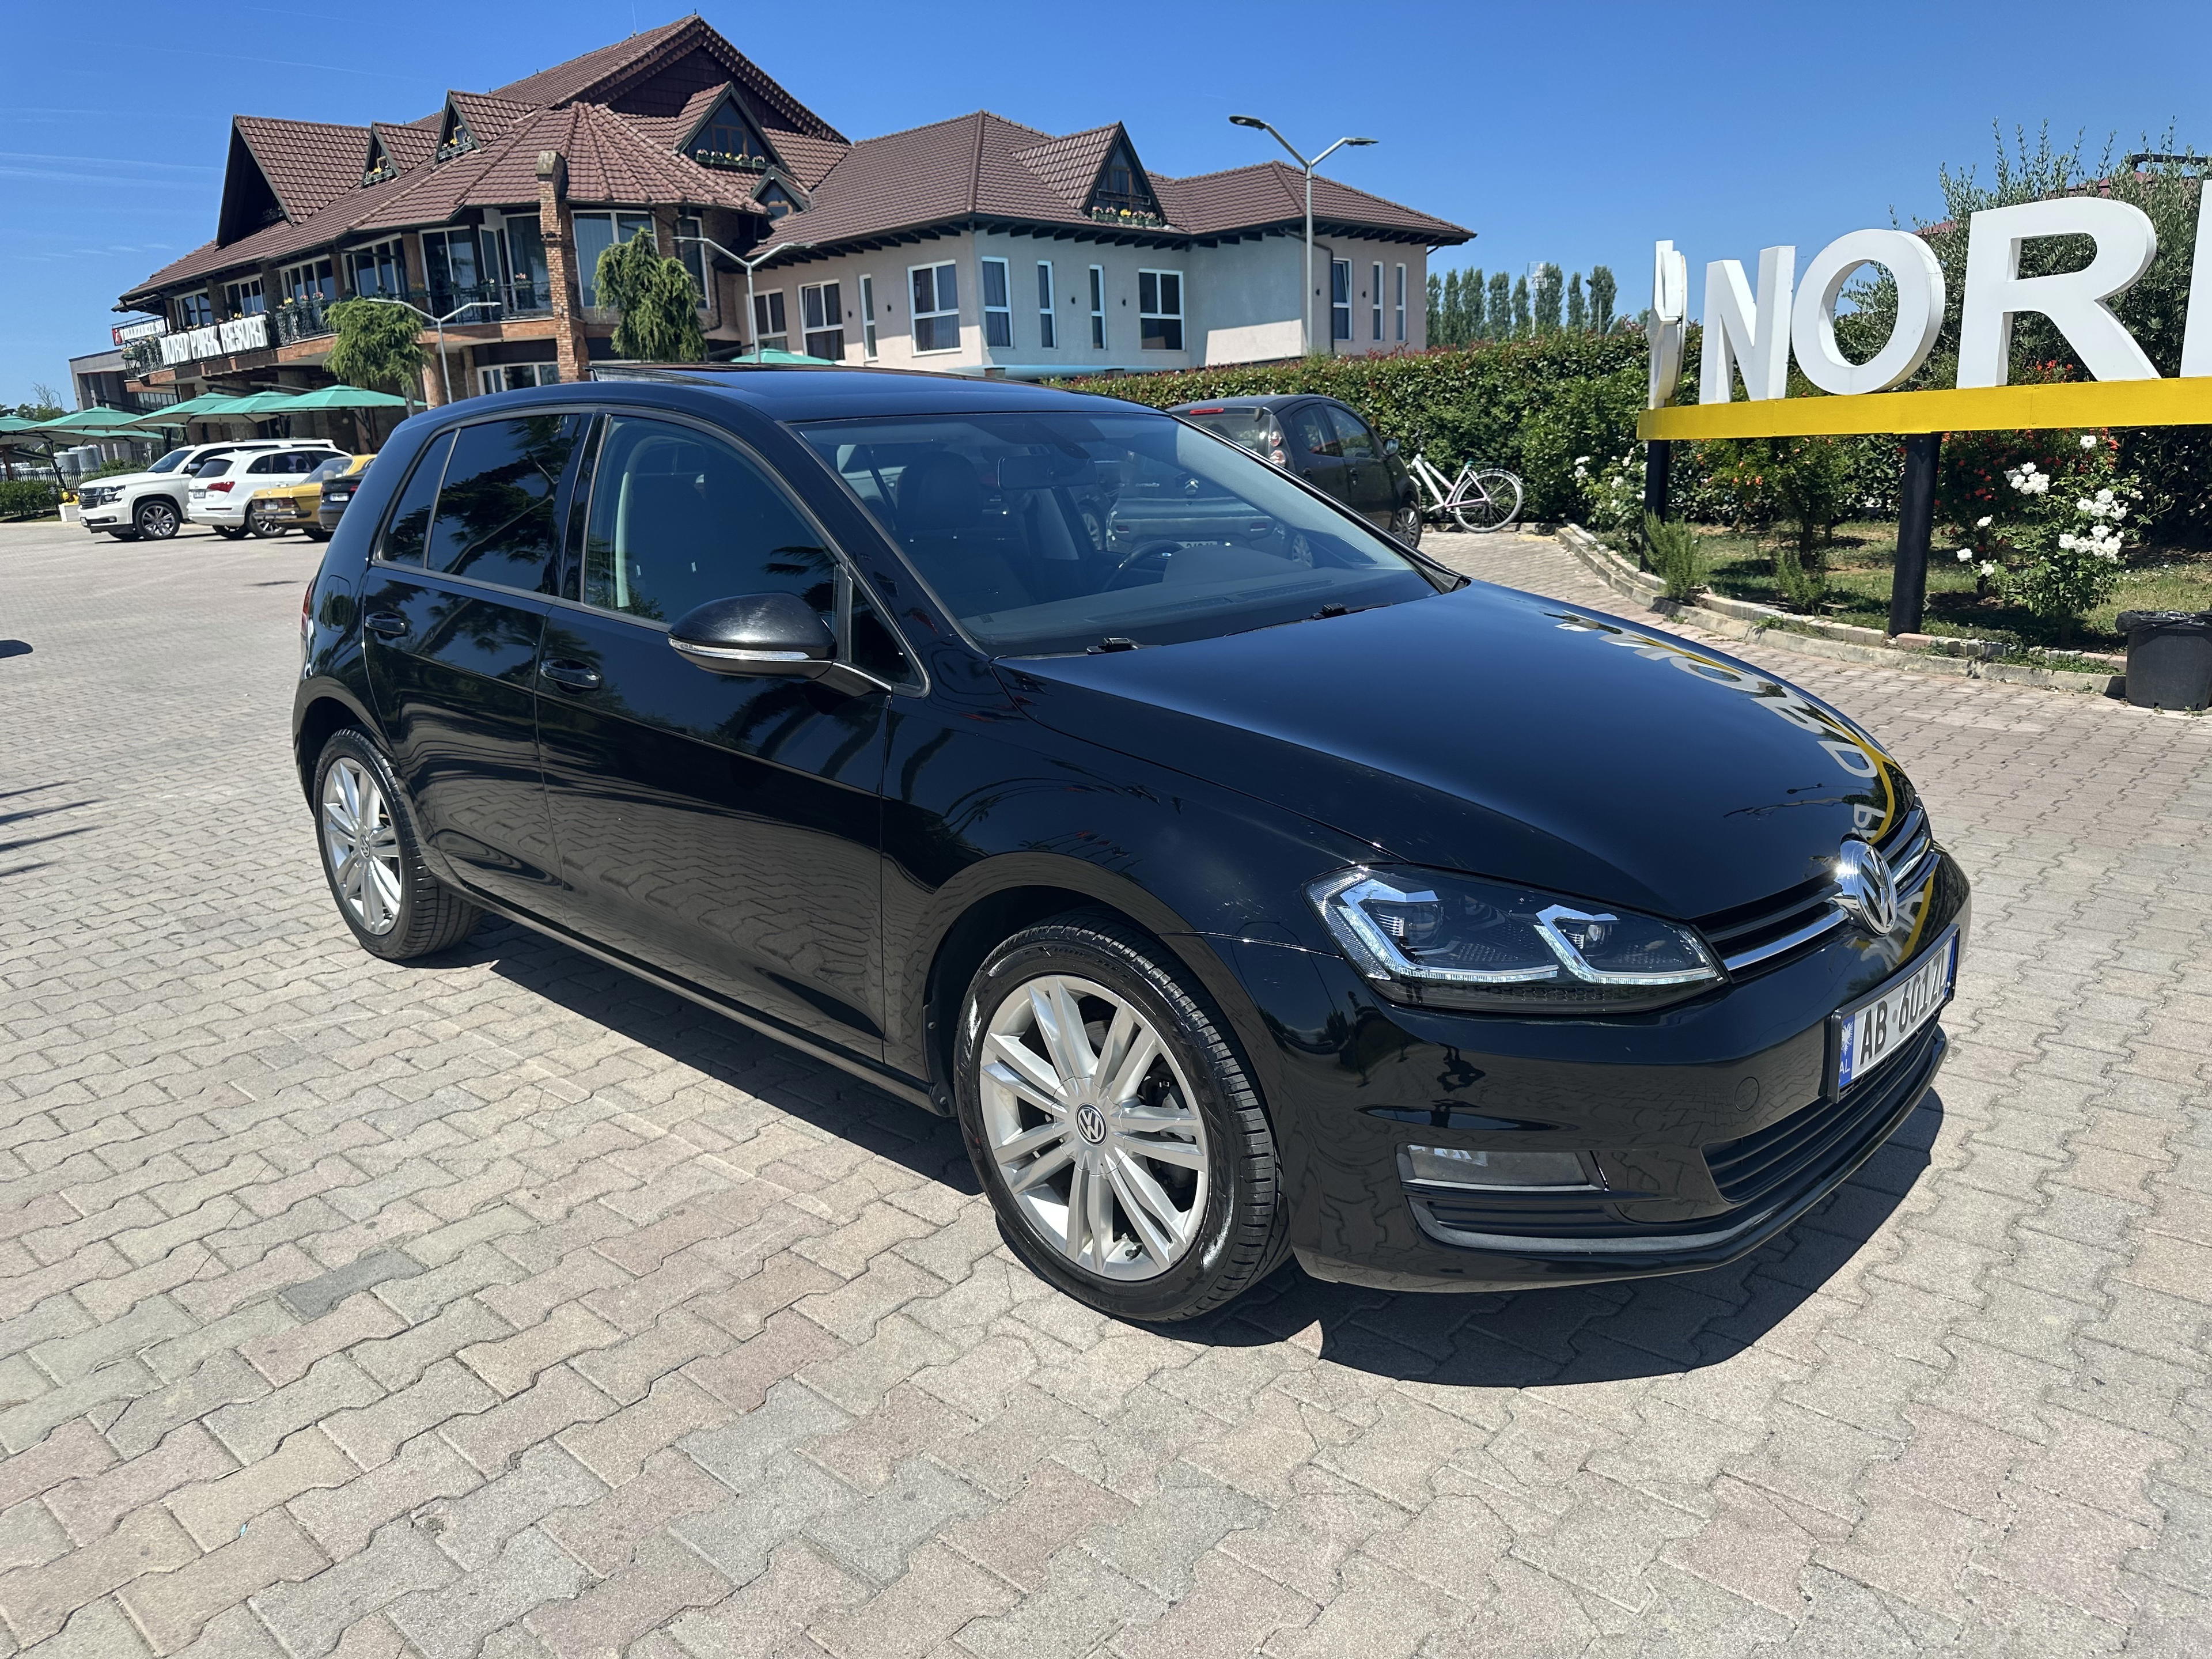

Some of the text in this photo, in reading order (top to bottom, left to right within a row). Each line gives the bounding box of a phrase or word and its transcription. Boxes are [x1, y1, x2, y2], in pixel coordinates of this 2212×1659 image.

[1699, 180, 2212, 404] NOR
[159, 315, 268, 365] NORD PARK RESORT
[1860, 1001, 1888, 1066] AB
